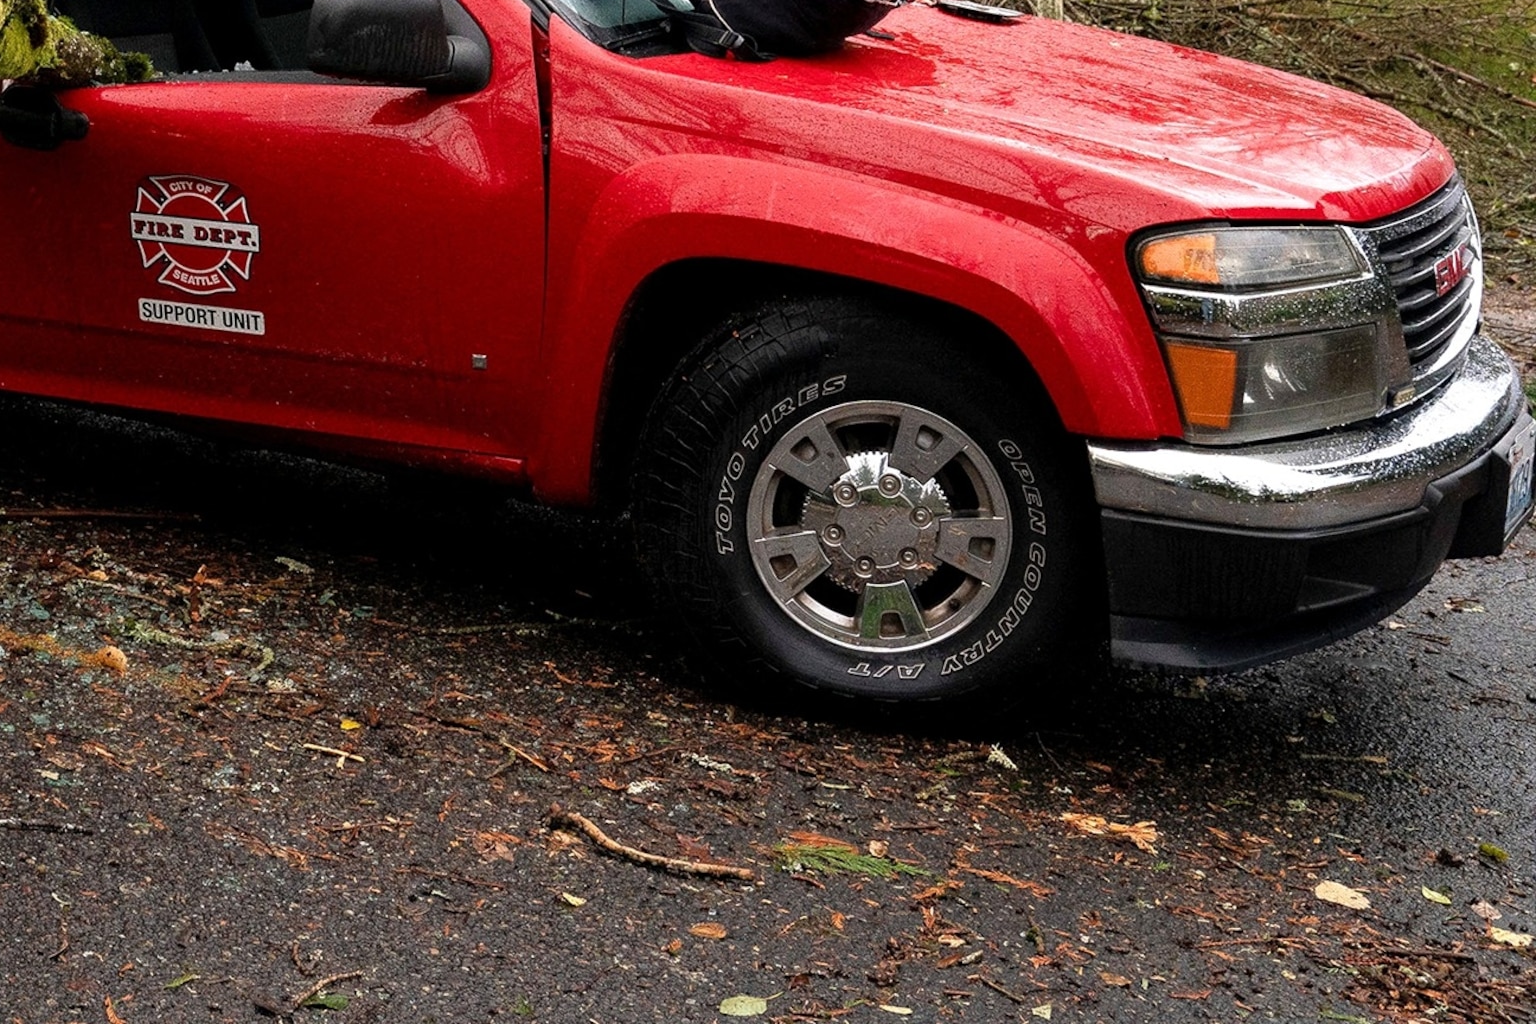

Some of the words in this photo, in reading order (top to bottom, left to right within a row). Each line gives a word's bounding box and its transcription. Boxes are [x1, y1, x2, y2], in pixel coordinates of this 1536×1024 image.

[169, 180, 194, 193] CITY
[196, 182, 213, 195] OF
[132, 219, 185, 240] FIRE
[193, 225, 258, 248] DEPT.
[172, 268, 221, 287] SEATTLE
[141, 301, 217, 326] SUPPORT
[222, 311, 262, 332] UNIT
[715, 451, 746, 555] TOYO
[741, 374, 848, 451] TIRES
[998, 438, 1047, 536] OPEN
[940, 541, 1047, 676] COUNTRY
[847, 662, 926, 680] A/T
